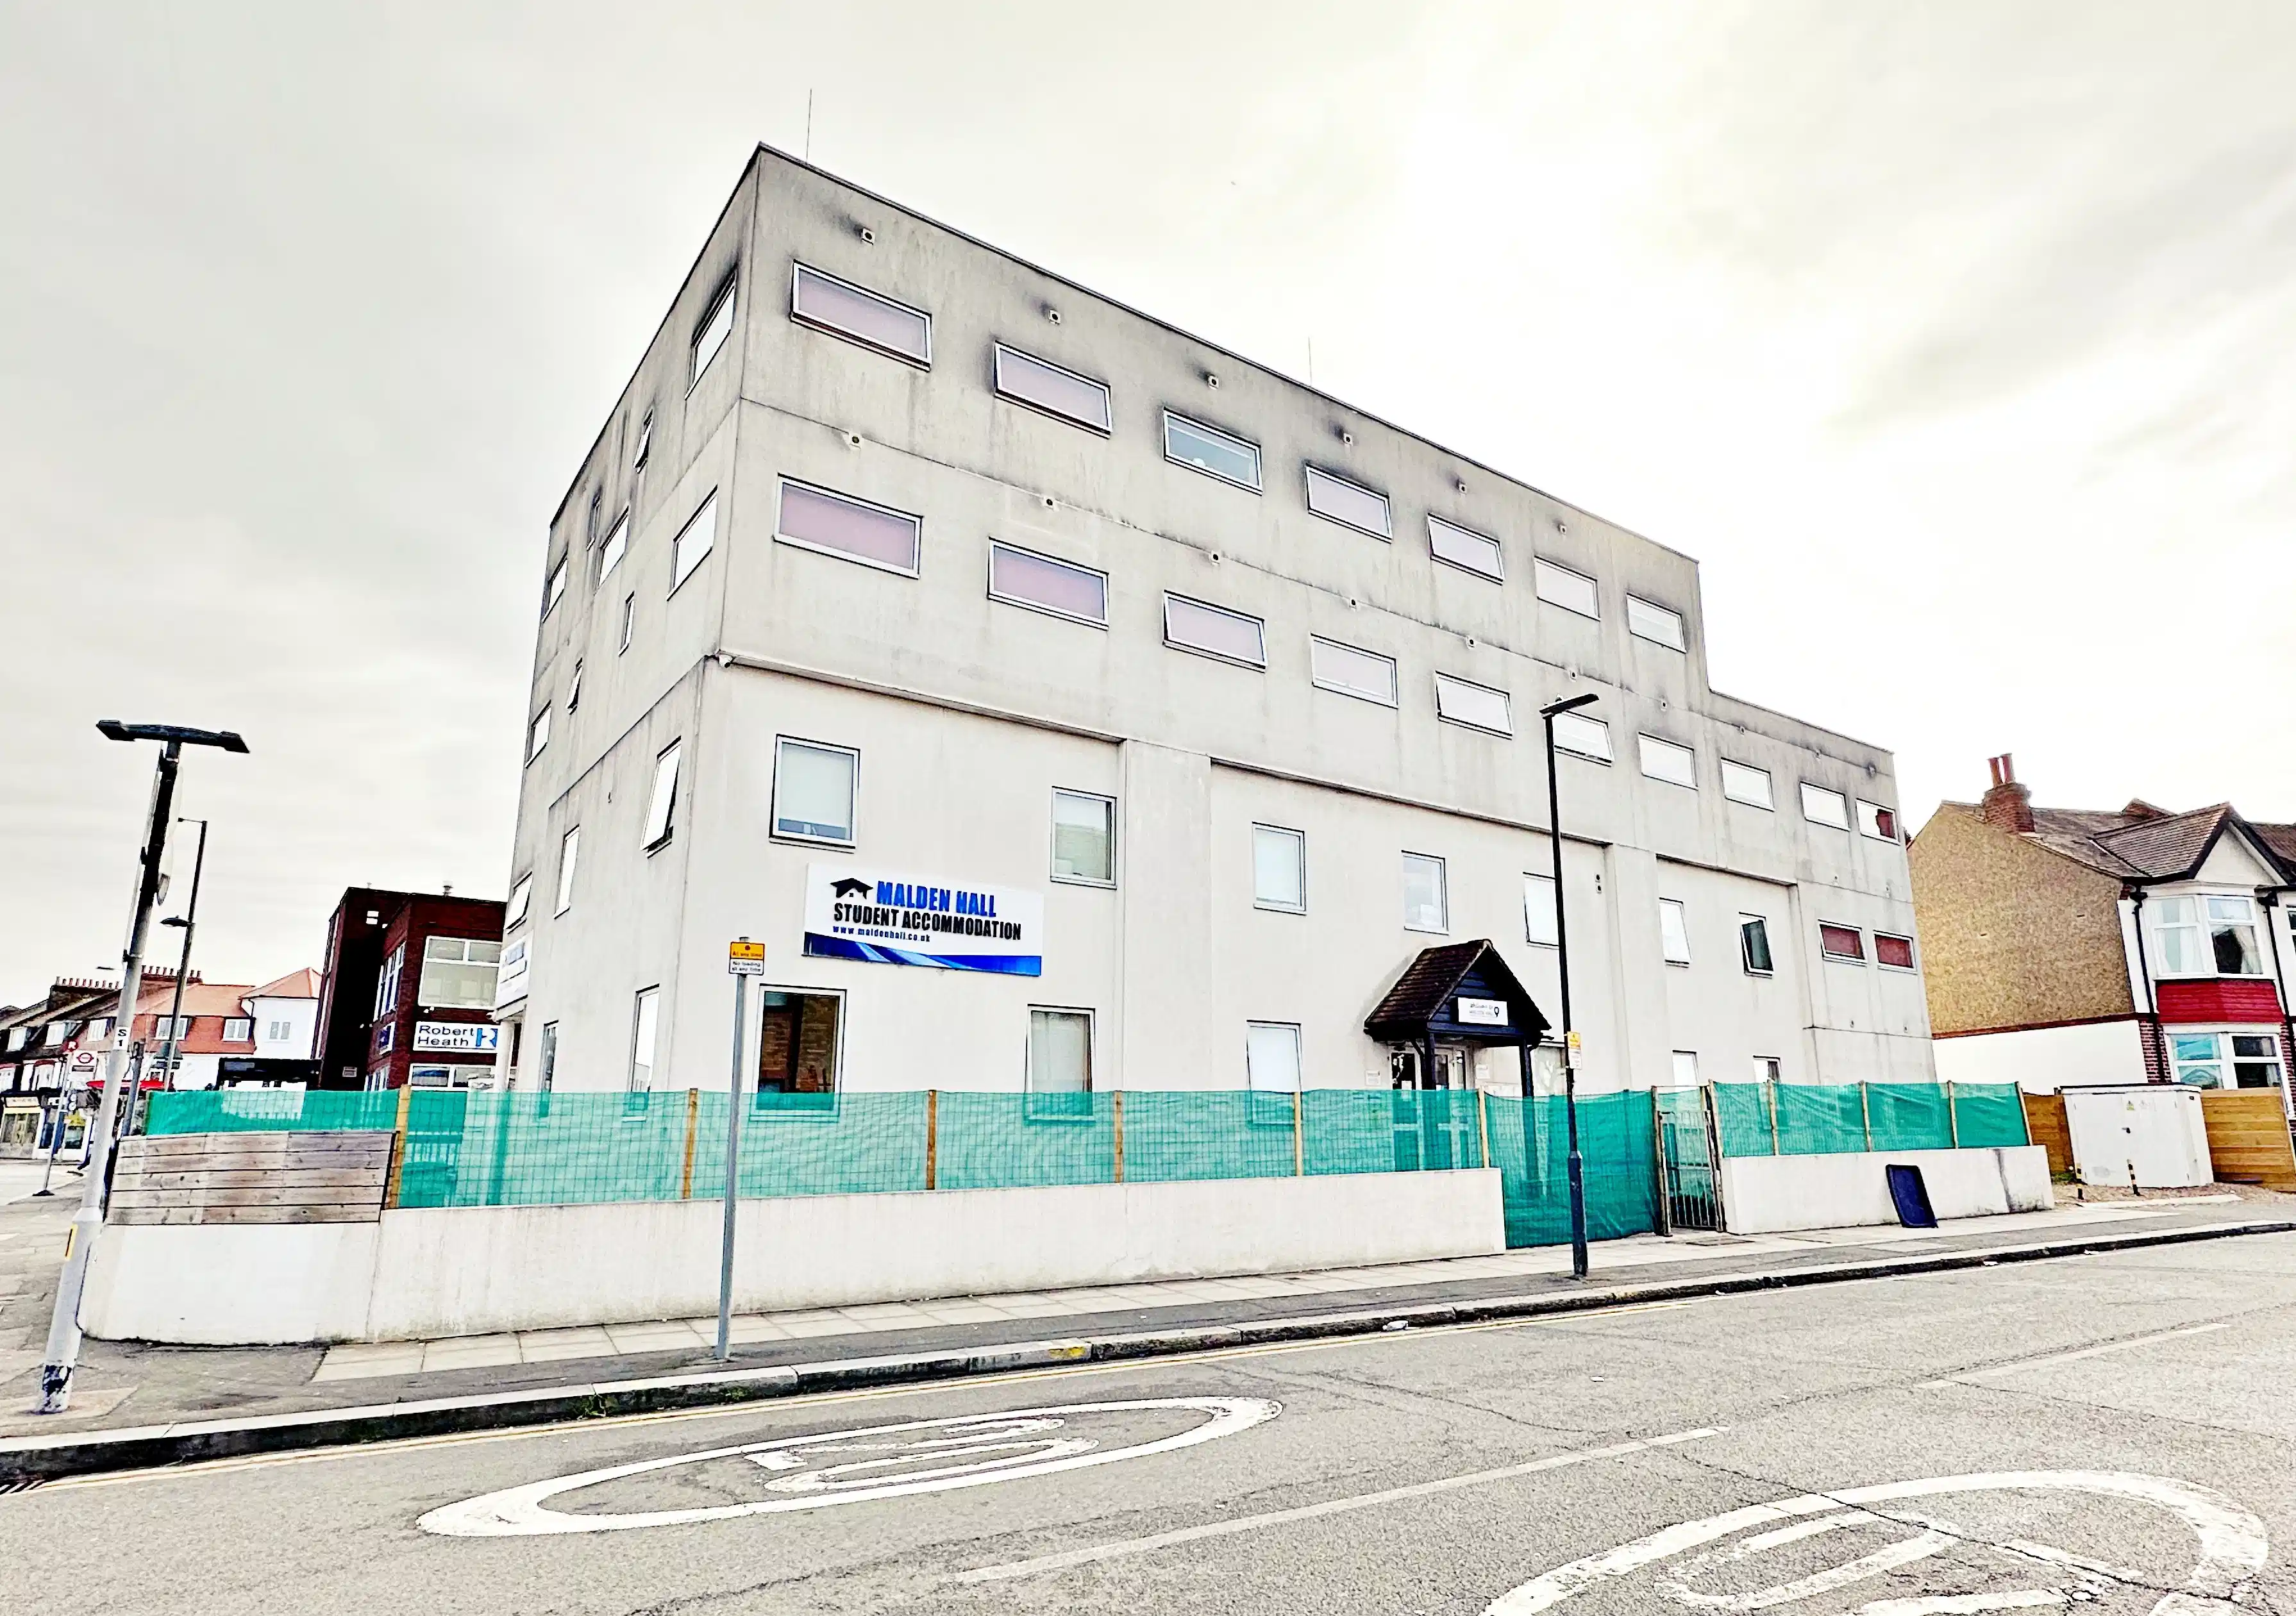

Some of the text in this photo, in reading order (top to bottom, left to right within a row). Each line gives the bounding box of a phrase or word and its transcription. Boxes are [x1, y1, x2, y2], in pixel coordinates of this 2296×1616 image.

[876, 880, 996, 917] MALDEN HALL
[834, 903, 1021, 940] STUDENT ACCOMMODATION
[417, 1036, 469, 1046] Heath
[419, 1025, 474, 1037] Robert
